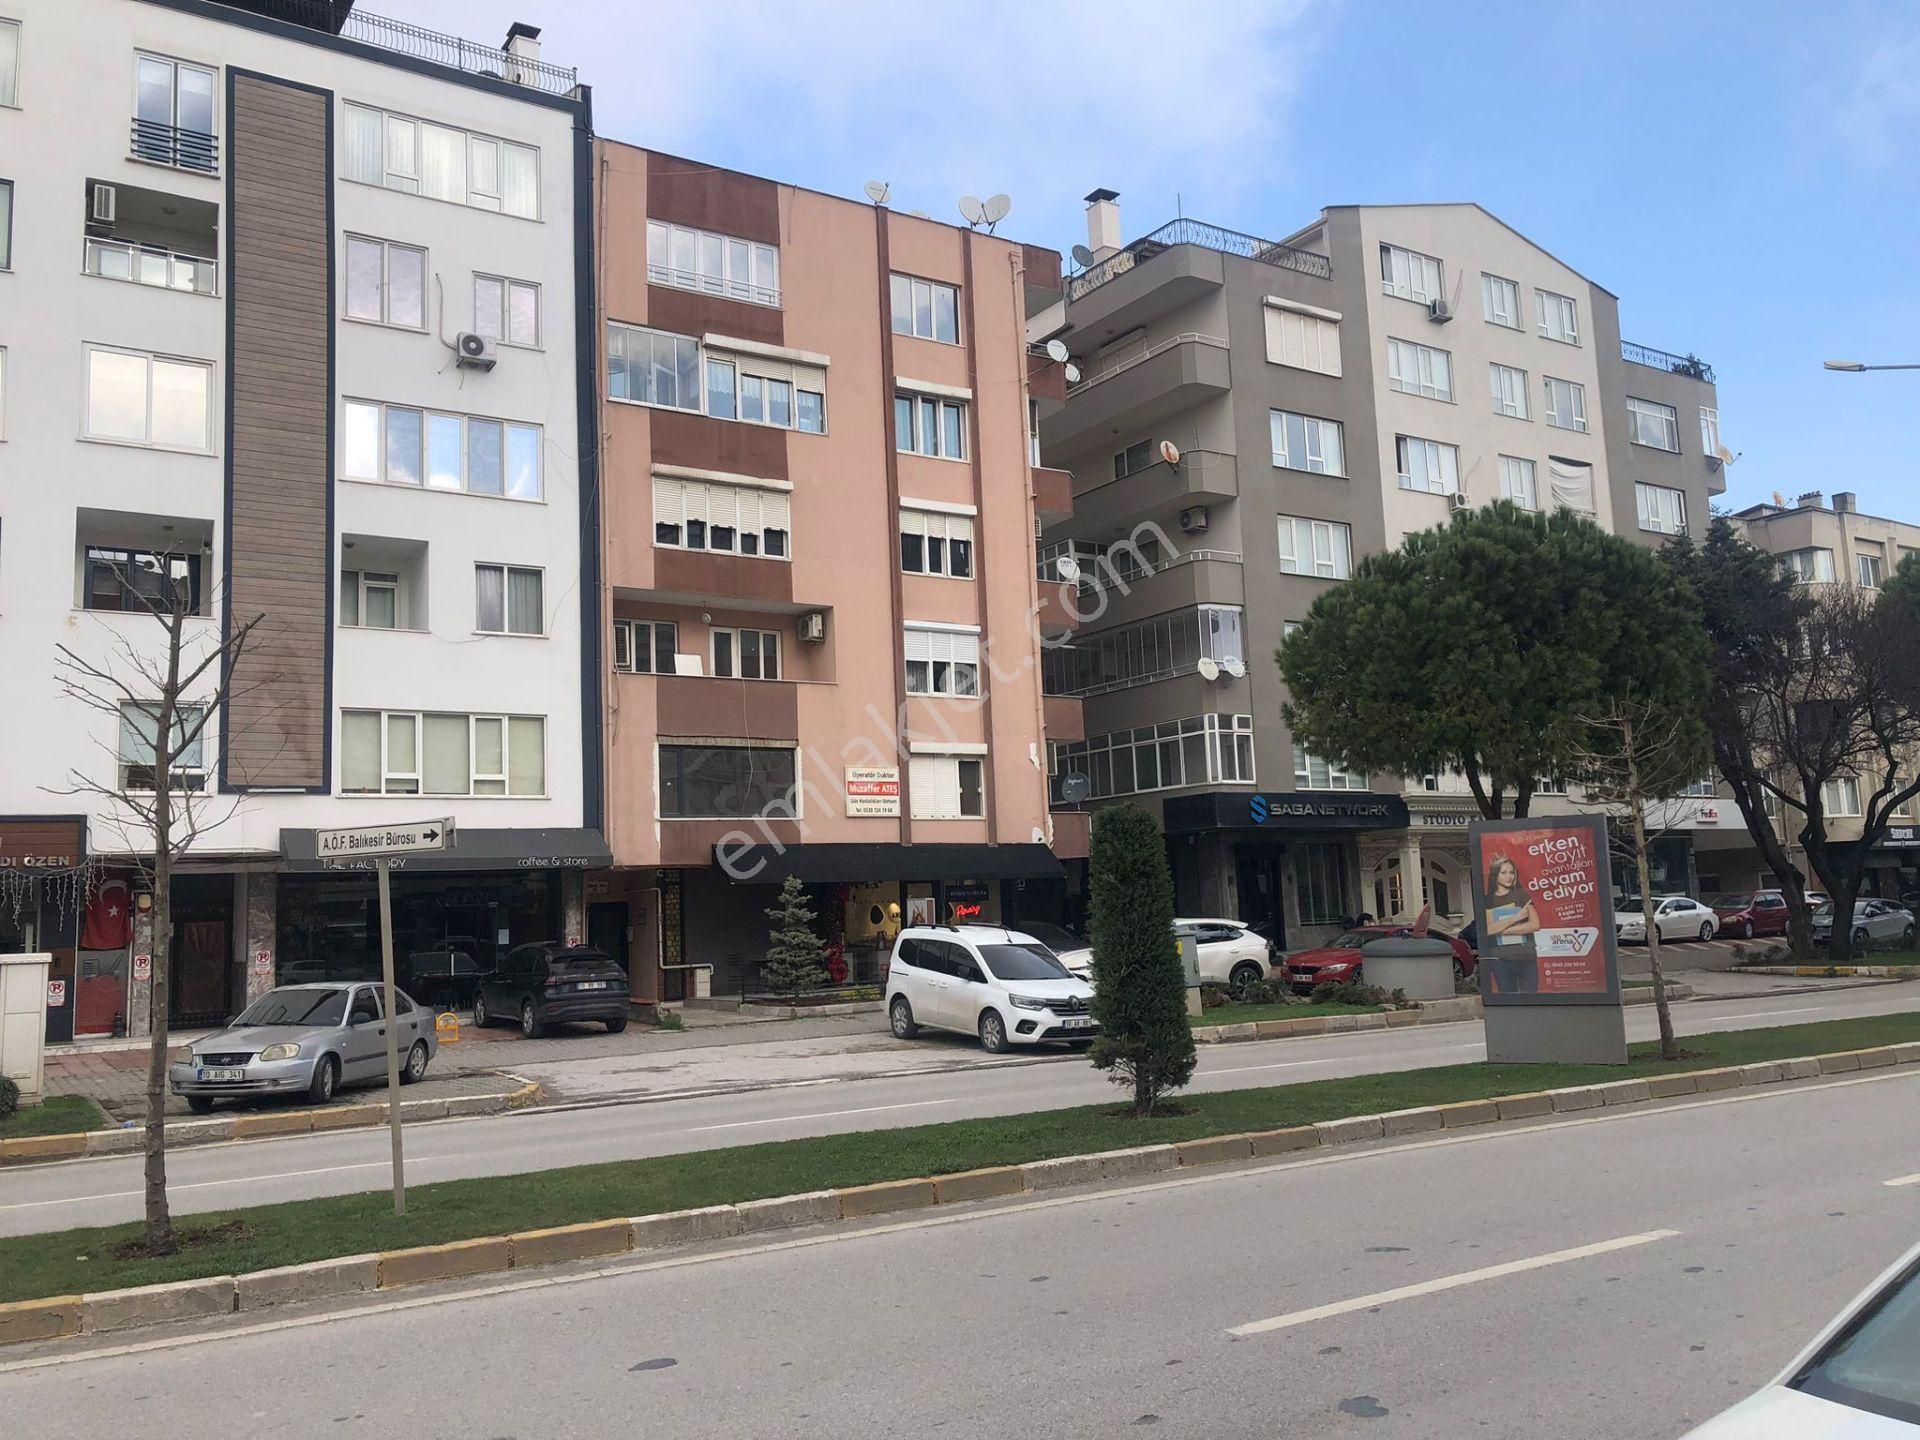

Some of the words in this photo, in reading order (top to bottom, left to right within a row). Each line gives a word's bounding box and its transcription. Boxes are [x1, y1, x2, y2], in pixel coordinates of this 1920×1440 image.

[849, 783, 881, 793] Muzaffer
[1528, 836, 1579, 856] erken
[1545, 844, 1587, 865] kayıt
[23, 853, 70, 867] ÖZEN
[518, 856, 549, 867] coffee
[551, 856, 560, 866] &
[563, 856, 589, 866] store
[1528, 871, 1586, 891] devam
[1543, 882, 1594, 900] ediyor
